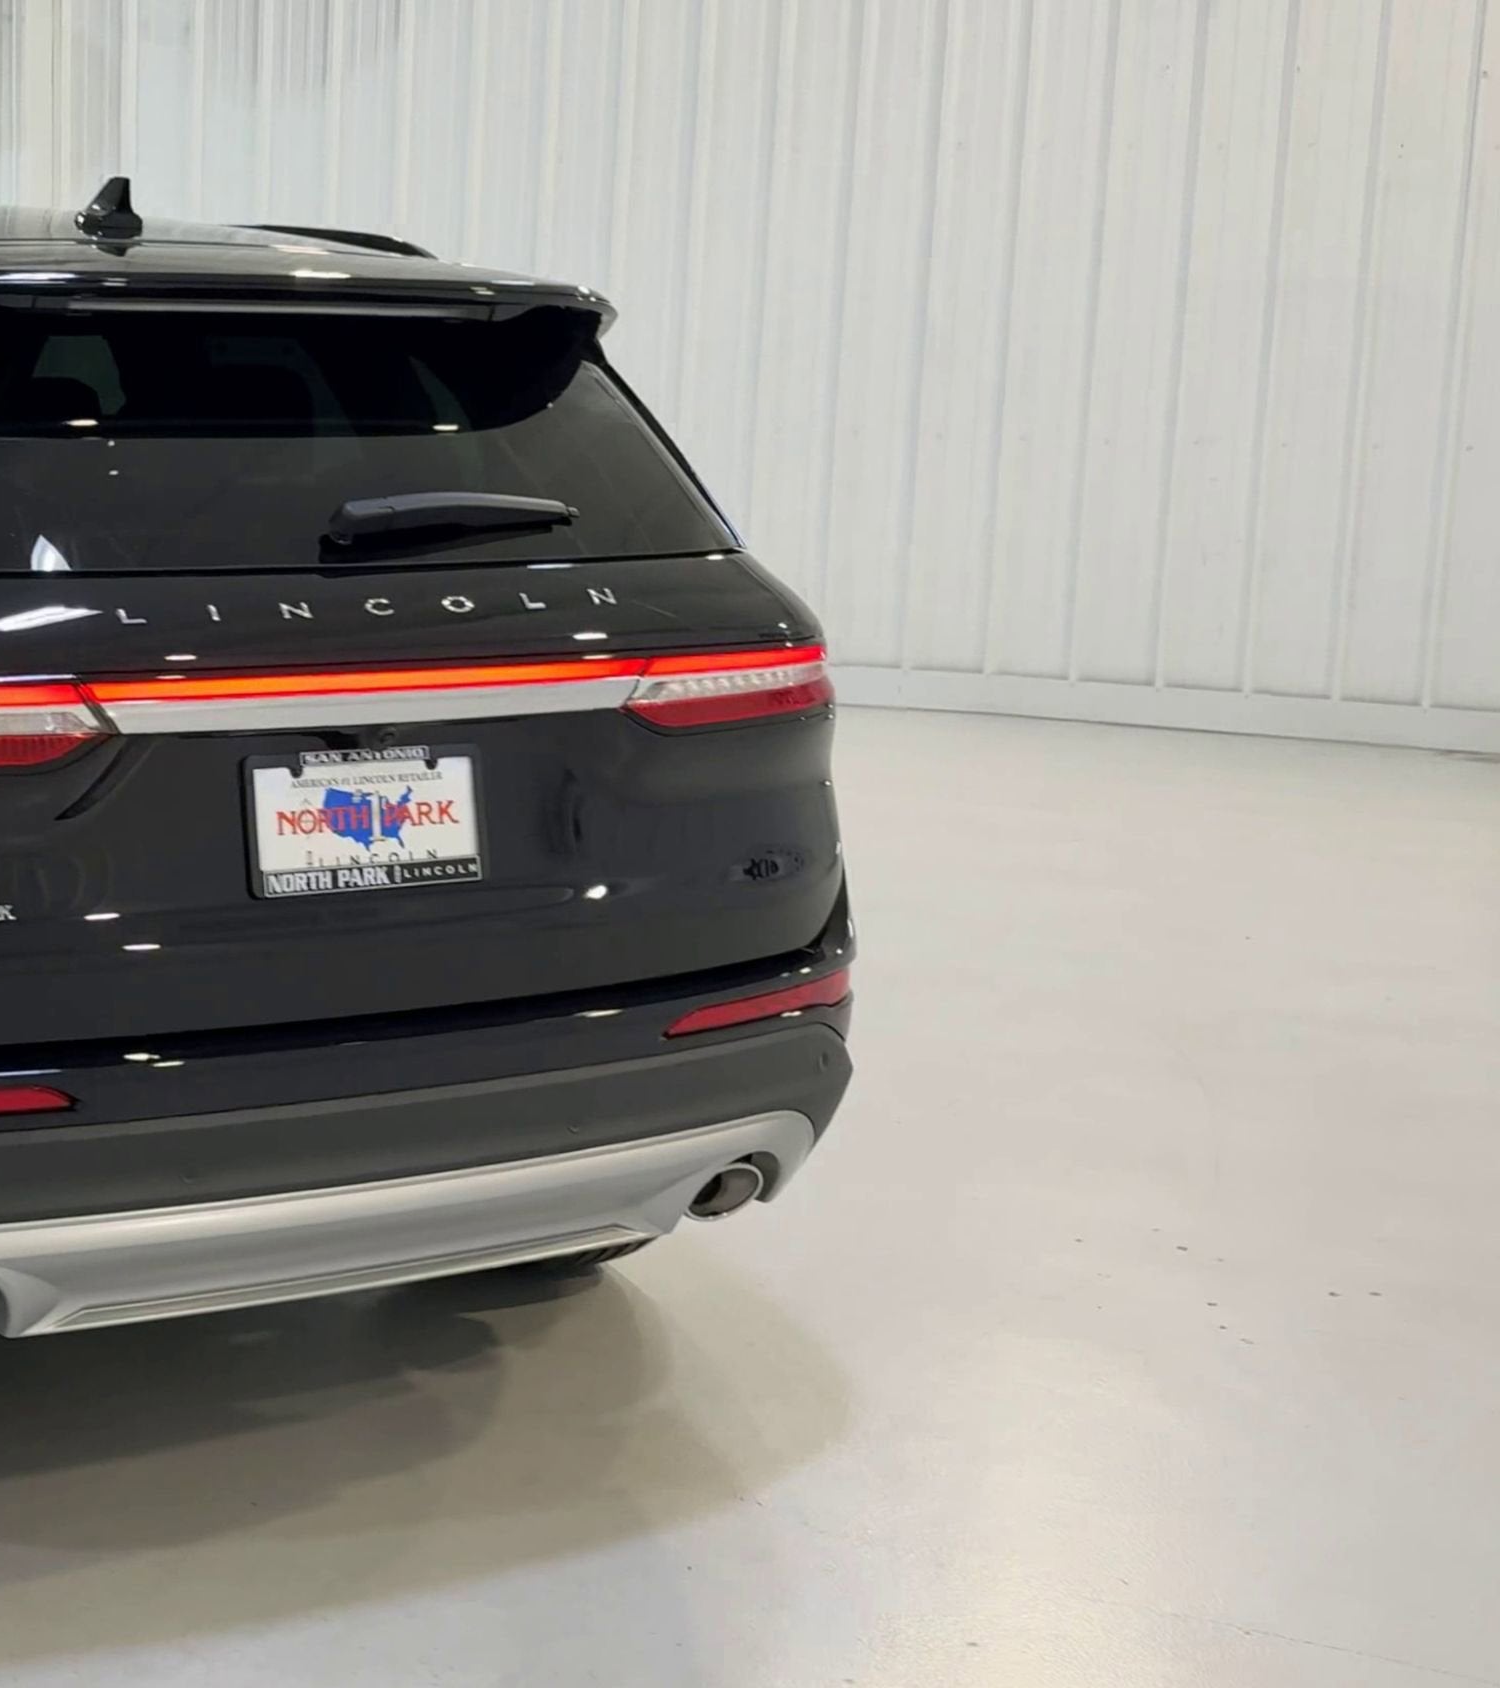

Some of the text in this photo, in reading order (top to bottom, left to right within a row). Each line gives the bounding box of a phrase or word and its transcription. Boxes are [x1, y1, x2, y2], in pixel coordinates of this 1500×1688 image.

[116, 588, 617, 625] LINCOLN
[305, 747, 423, 765] SAN ANTONIO
[398, 771, 443, 782] RETAILER
[276, 800, 459, 836] NORTH PARK
[319, 850, 439, 868] LINCOLN
[268, 863, 478, 894] NORTH PARK LINCOLN
